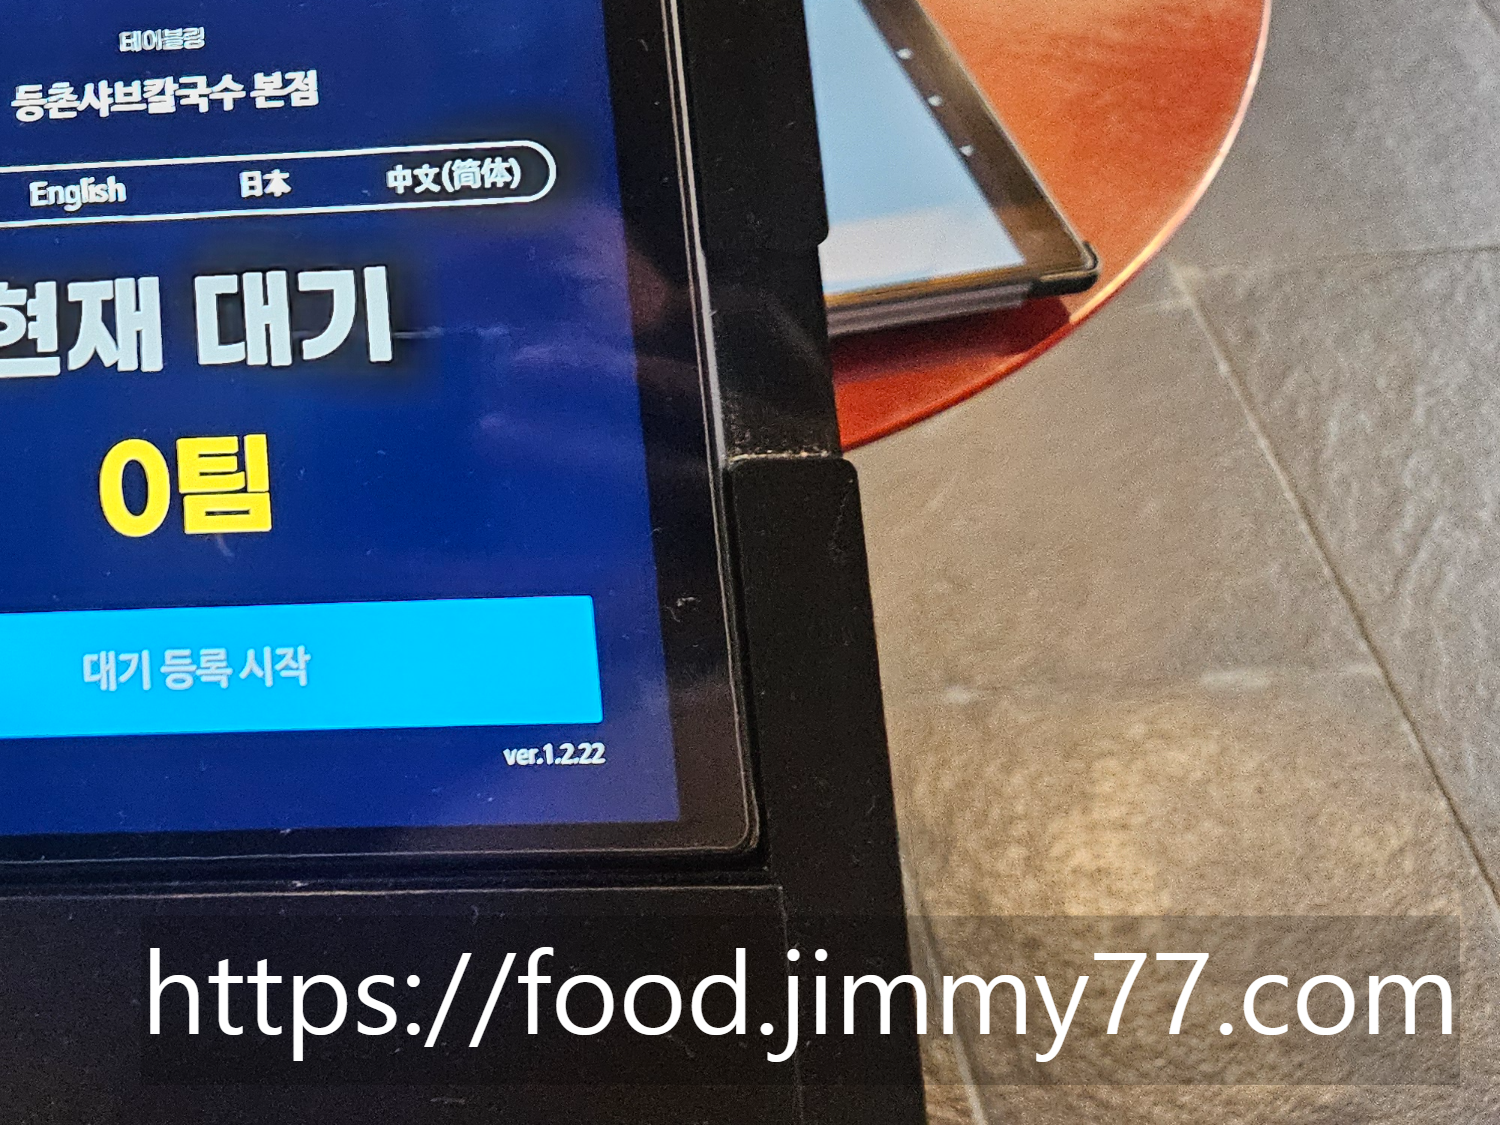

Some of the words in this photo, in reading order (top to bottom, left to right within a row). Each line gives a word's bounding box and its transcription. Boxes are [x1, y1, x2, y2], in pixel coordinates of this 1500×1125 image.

[118, 27, 206, 53] 테이블링
[10, 76, 246, 123] 등촌샤브칼국수
[250, 70, 320, 109] 본점
[28, 176, 127, 213] English
[240, 169, 292, 199] 日本
[194, 265, 393, 368] 대기
[98, 433, 272, 538] 0팀
[82, 649, 153, 691] 대기
[159, 648, 233, 690] 등록
[238, 645, 311, 687] 시작
[503, 742, 606, 767] ver.1.2.22
